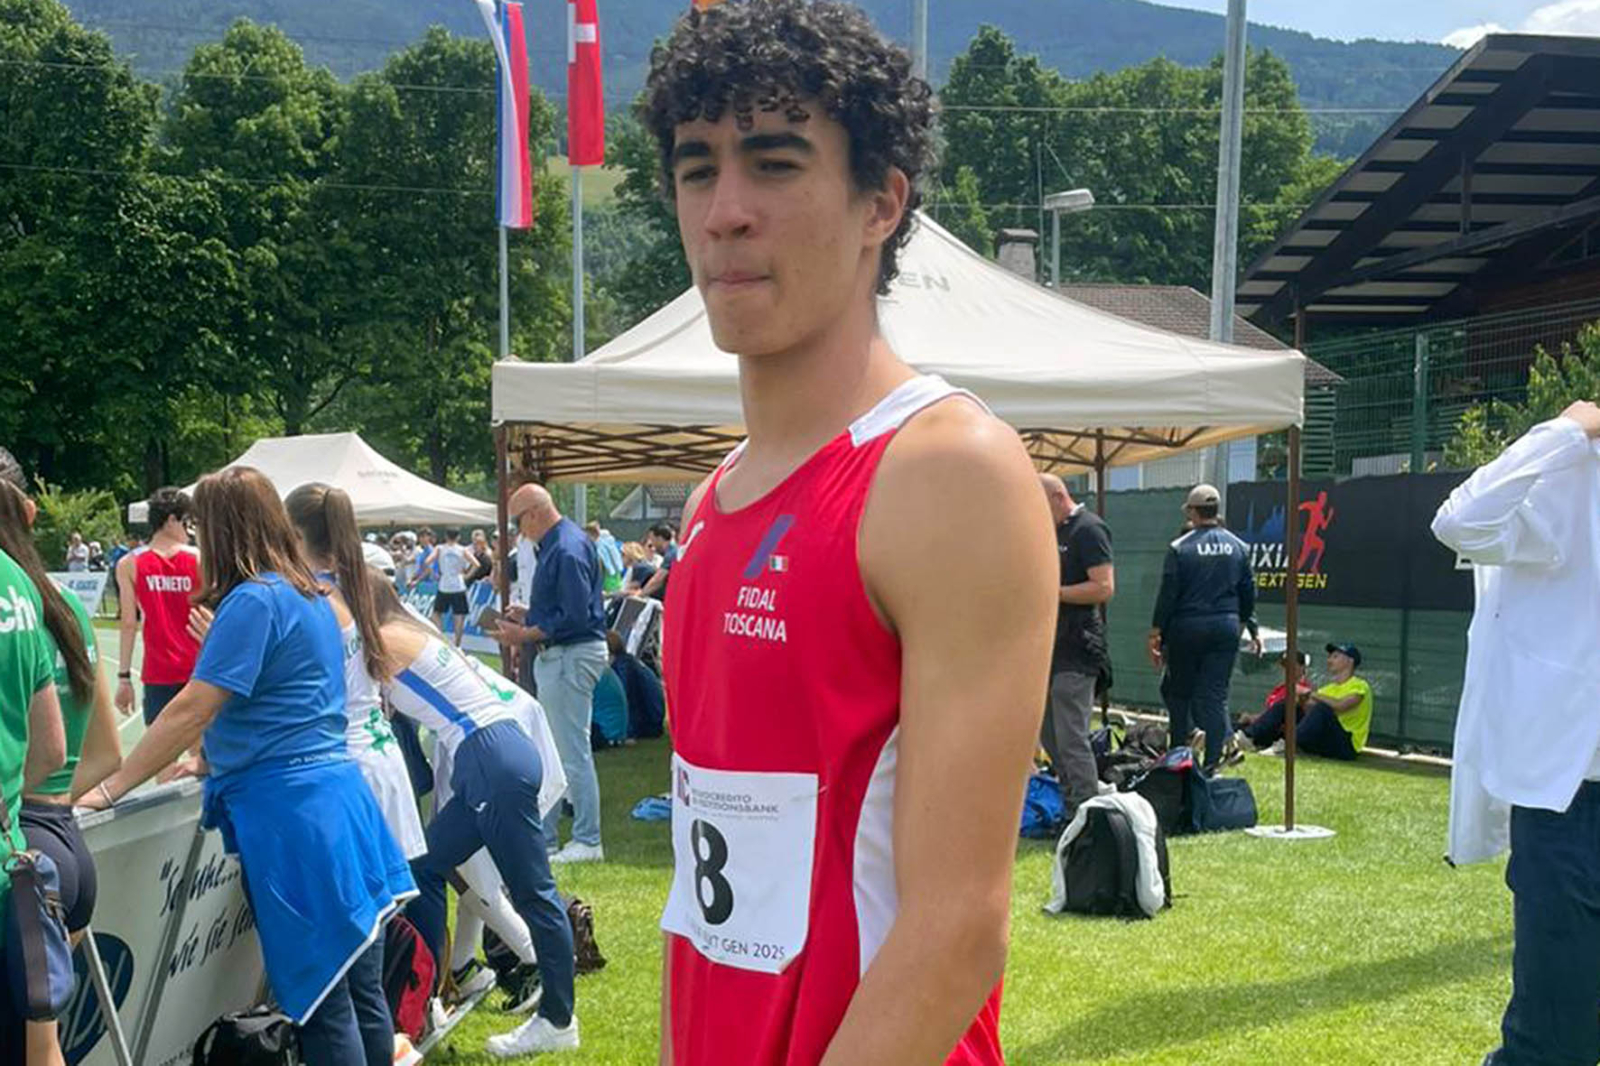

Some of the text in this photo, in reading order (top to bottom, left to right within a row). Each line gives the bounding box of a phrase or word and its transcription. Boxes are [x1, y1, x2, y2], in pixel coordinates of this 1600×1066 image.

[1196, 542, 1233, 556] LAZIO
[145, 574, 192, 592] VENETO
[737, 585, 776, 612] FIDAL
[723, 612, 787, 643] TOSCANA
[691, 819, 734, 925] 8
[721, 938, 748, 955] GEN
[753, 942, 785, 960] 2025
